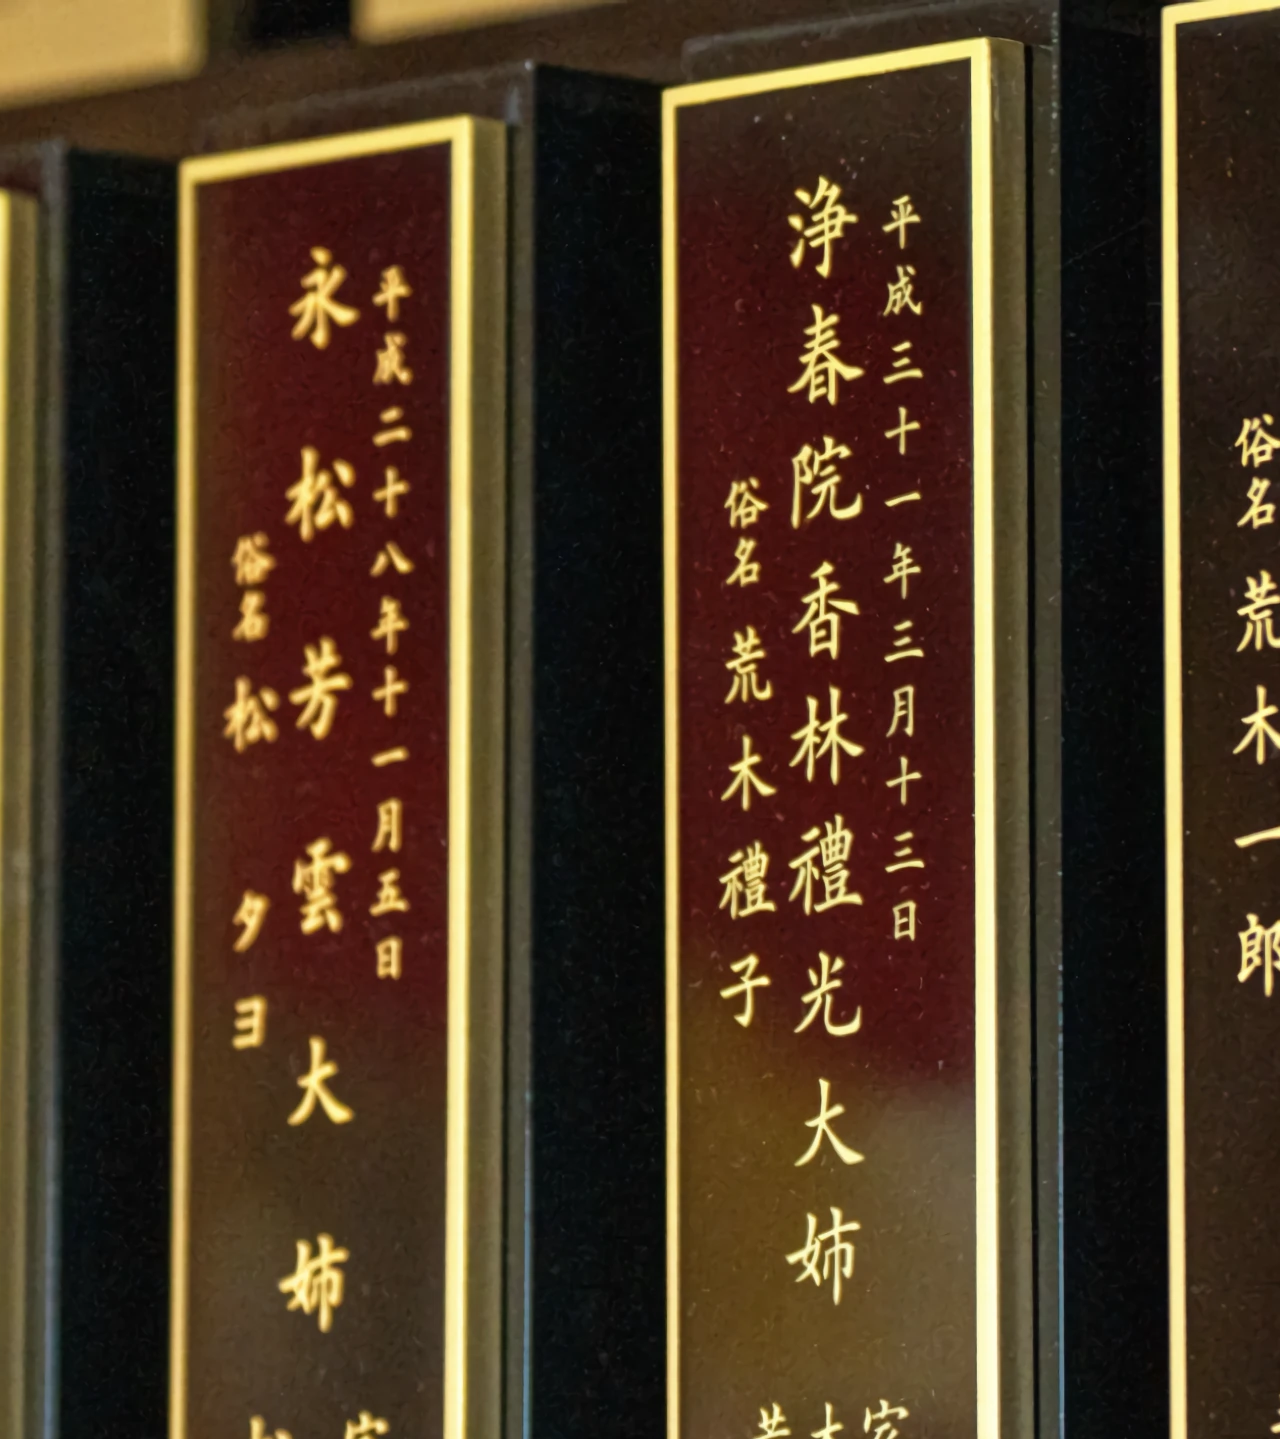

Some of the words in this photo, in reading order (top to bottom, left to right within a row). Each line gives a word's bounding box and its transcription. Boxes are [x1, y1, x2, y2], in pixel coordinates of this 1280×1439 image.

[278, 247, 360, 1333] 永松芳雲大姉
[369, 265, 414, 980] 平成二十八年十一月五日
[717, 478, 778, 1029] 俗名荒木禮子
[785, 175, 866, 1306] 浄春院香林禮光大姉
[882, 195, 925, 942] 平成三十一年三月十三日
